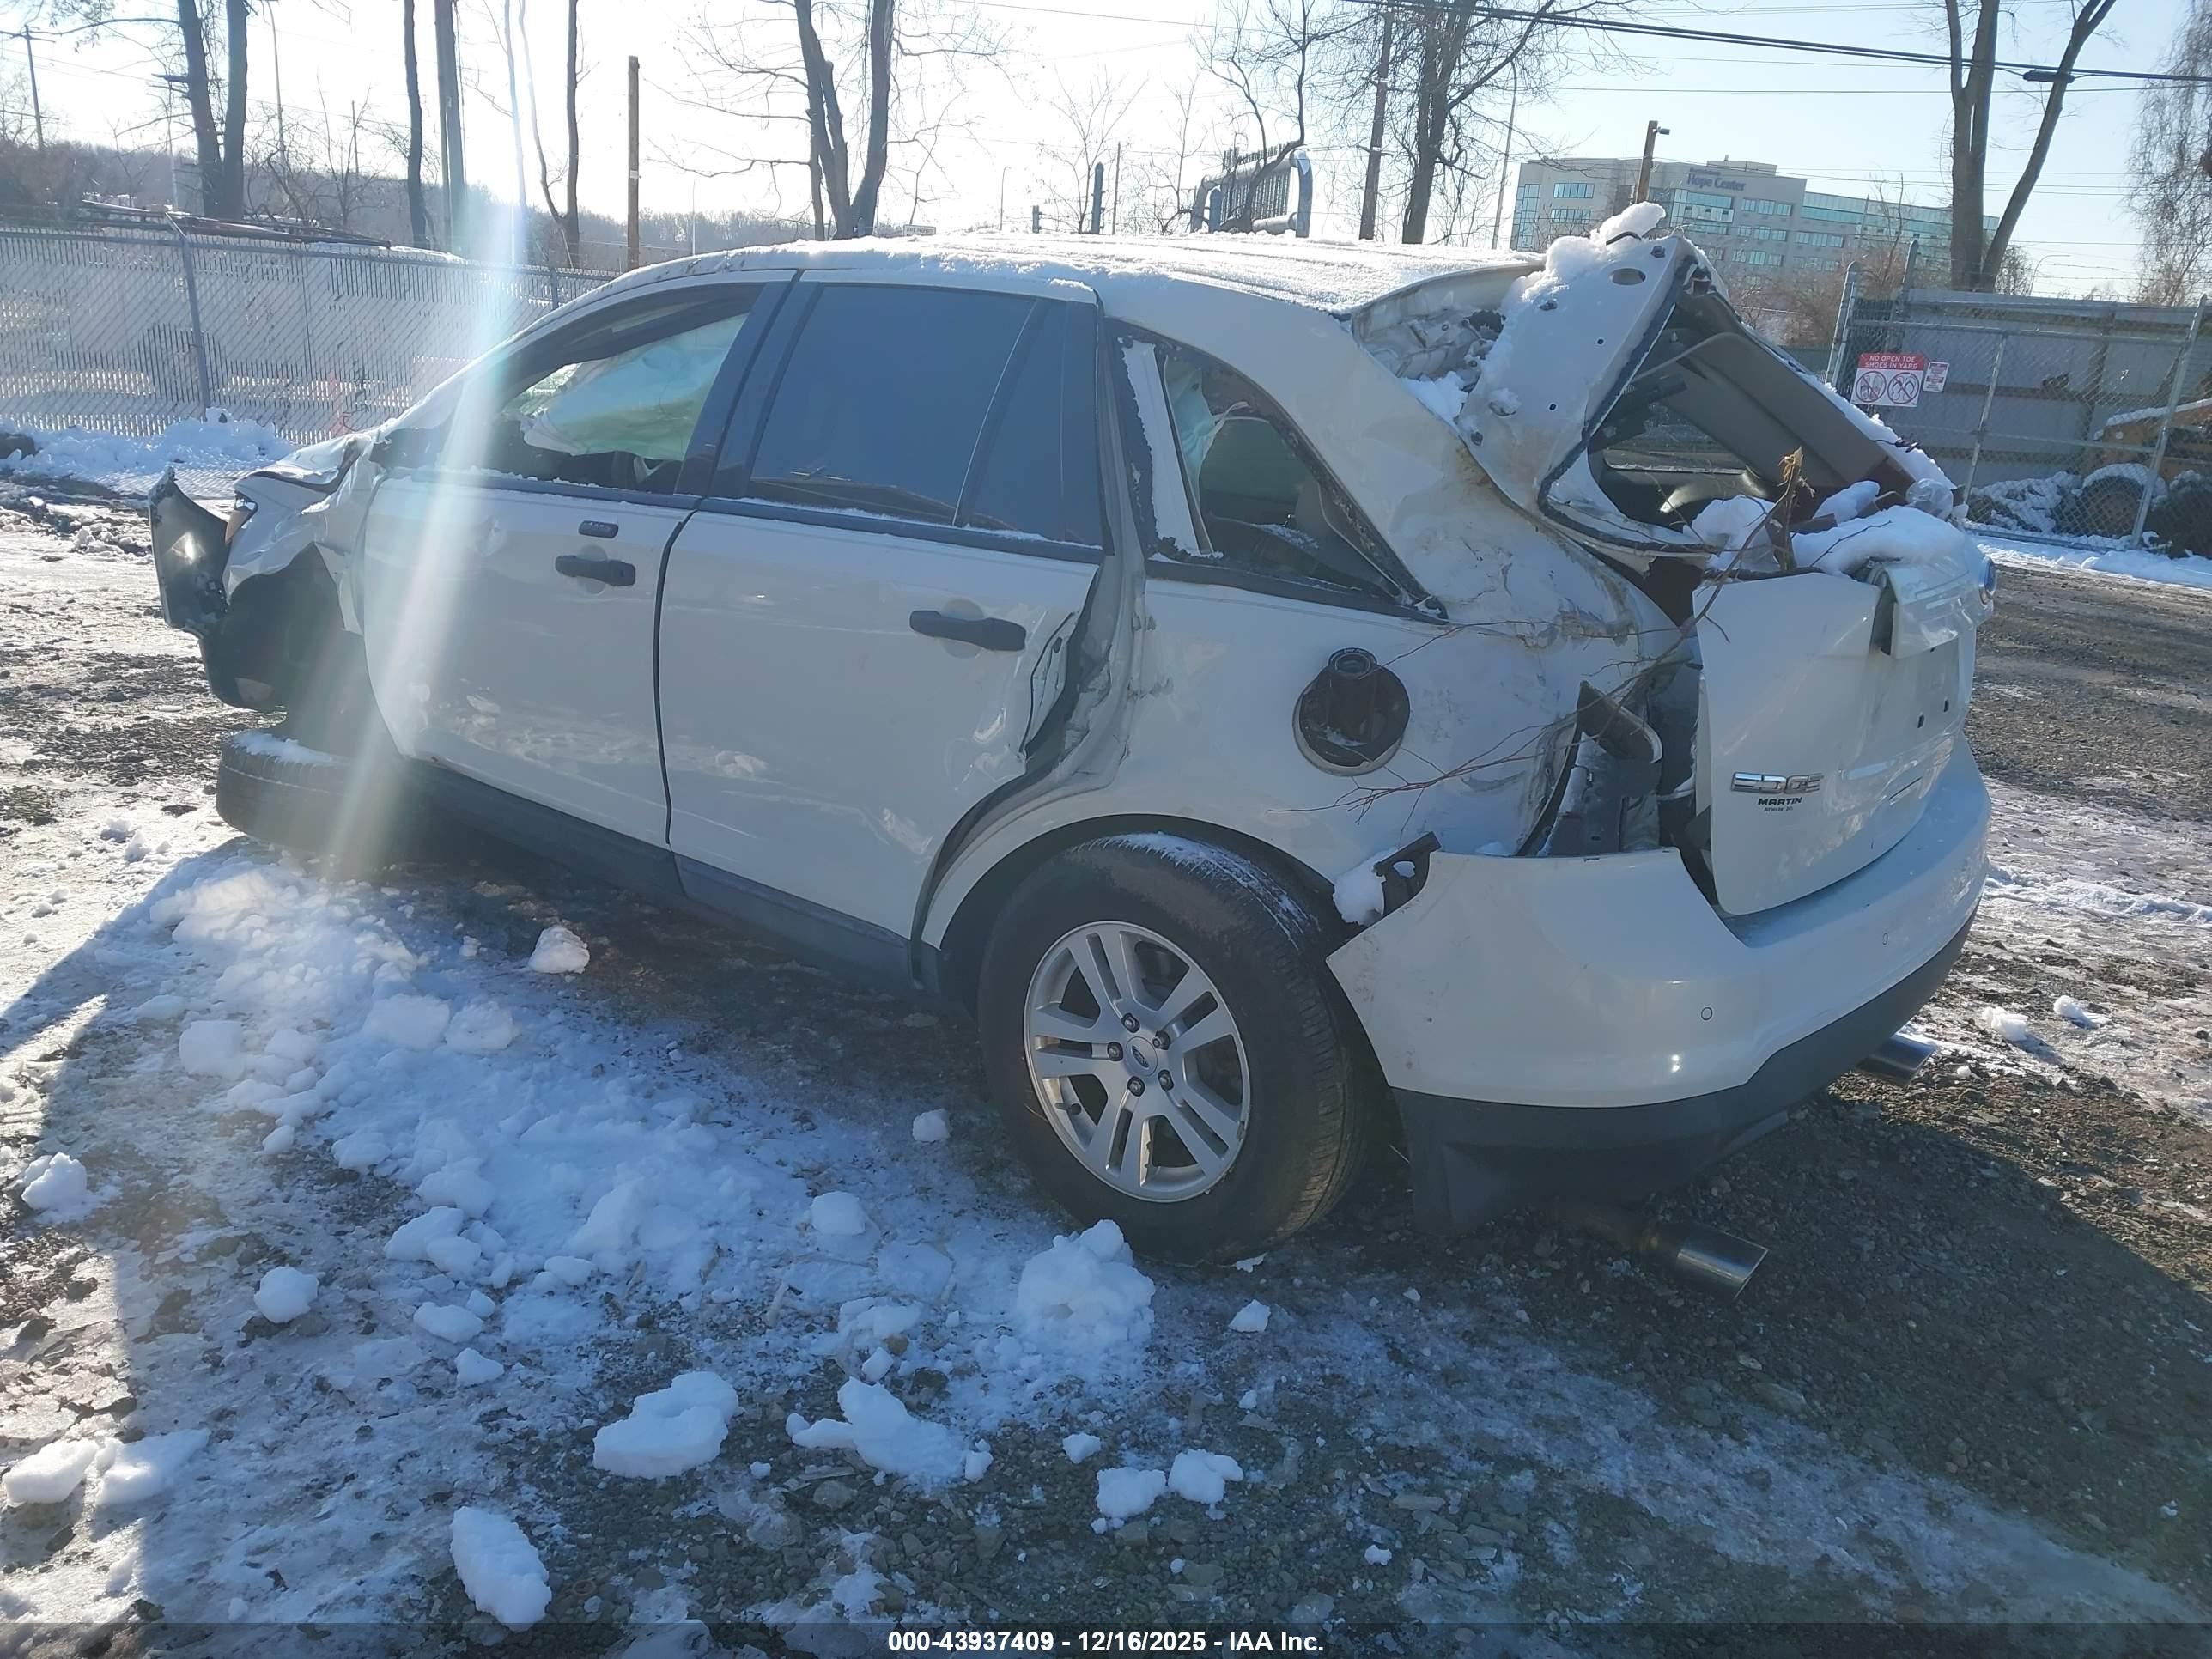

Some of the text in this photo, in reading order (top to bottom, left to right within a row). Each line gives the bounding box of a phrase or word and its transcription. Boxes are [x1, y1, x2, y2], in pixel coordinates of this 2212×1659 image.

[1687, 173, 1747, 191] Hope Center
[1731, 771, 1824, 794] EDGE
[1758, 797, 1802, 806] MARTIN
